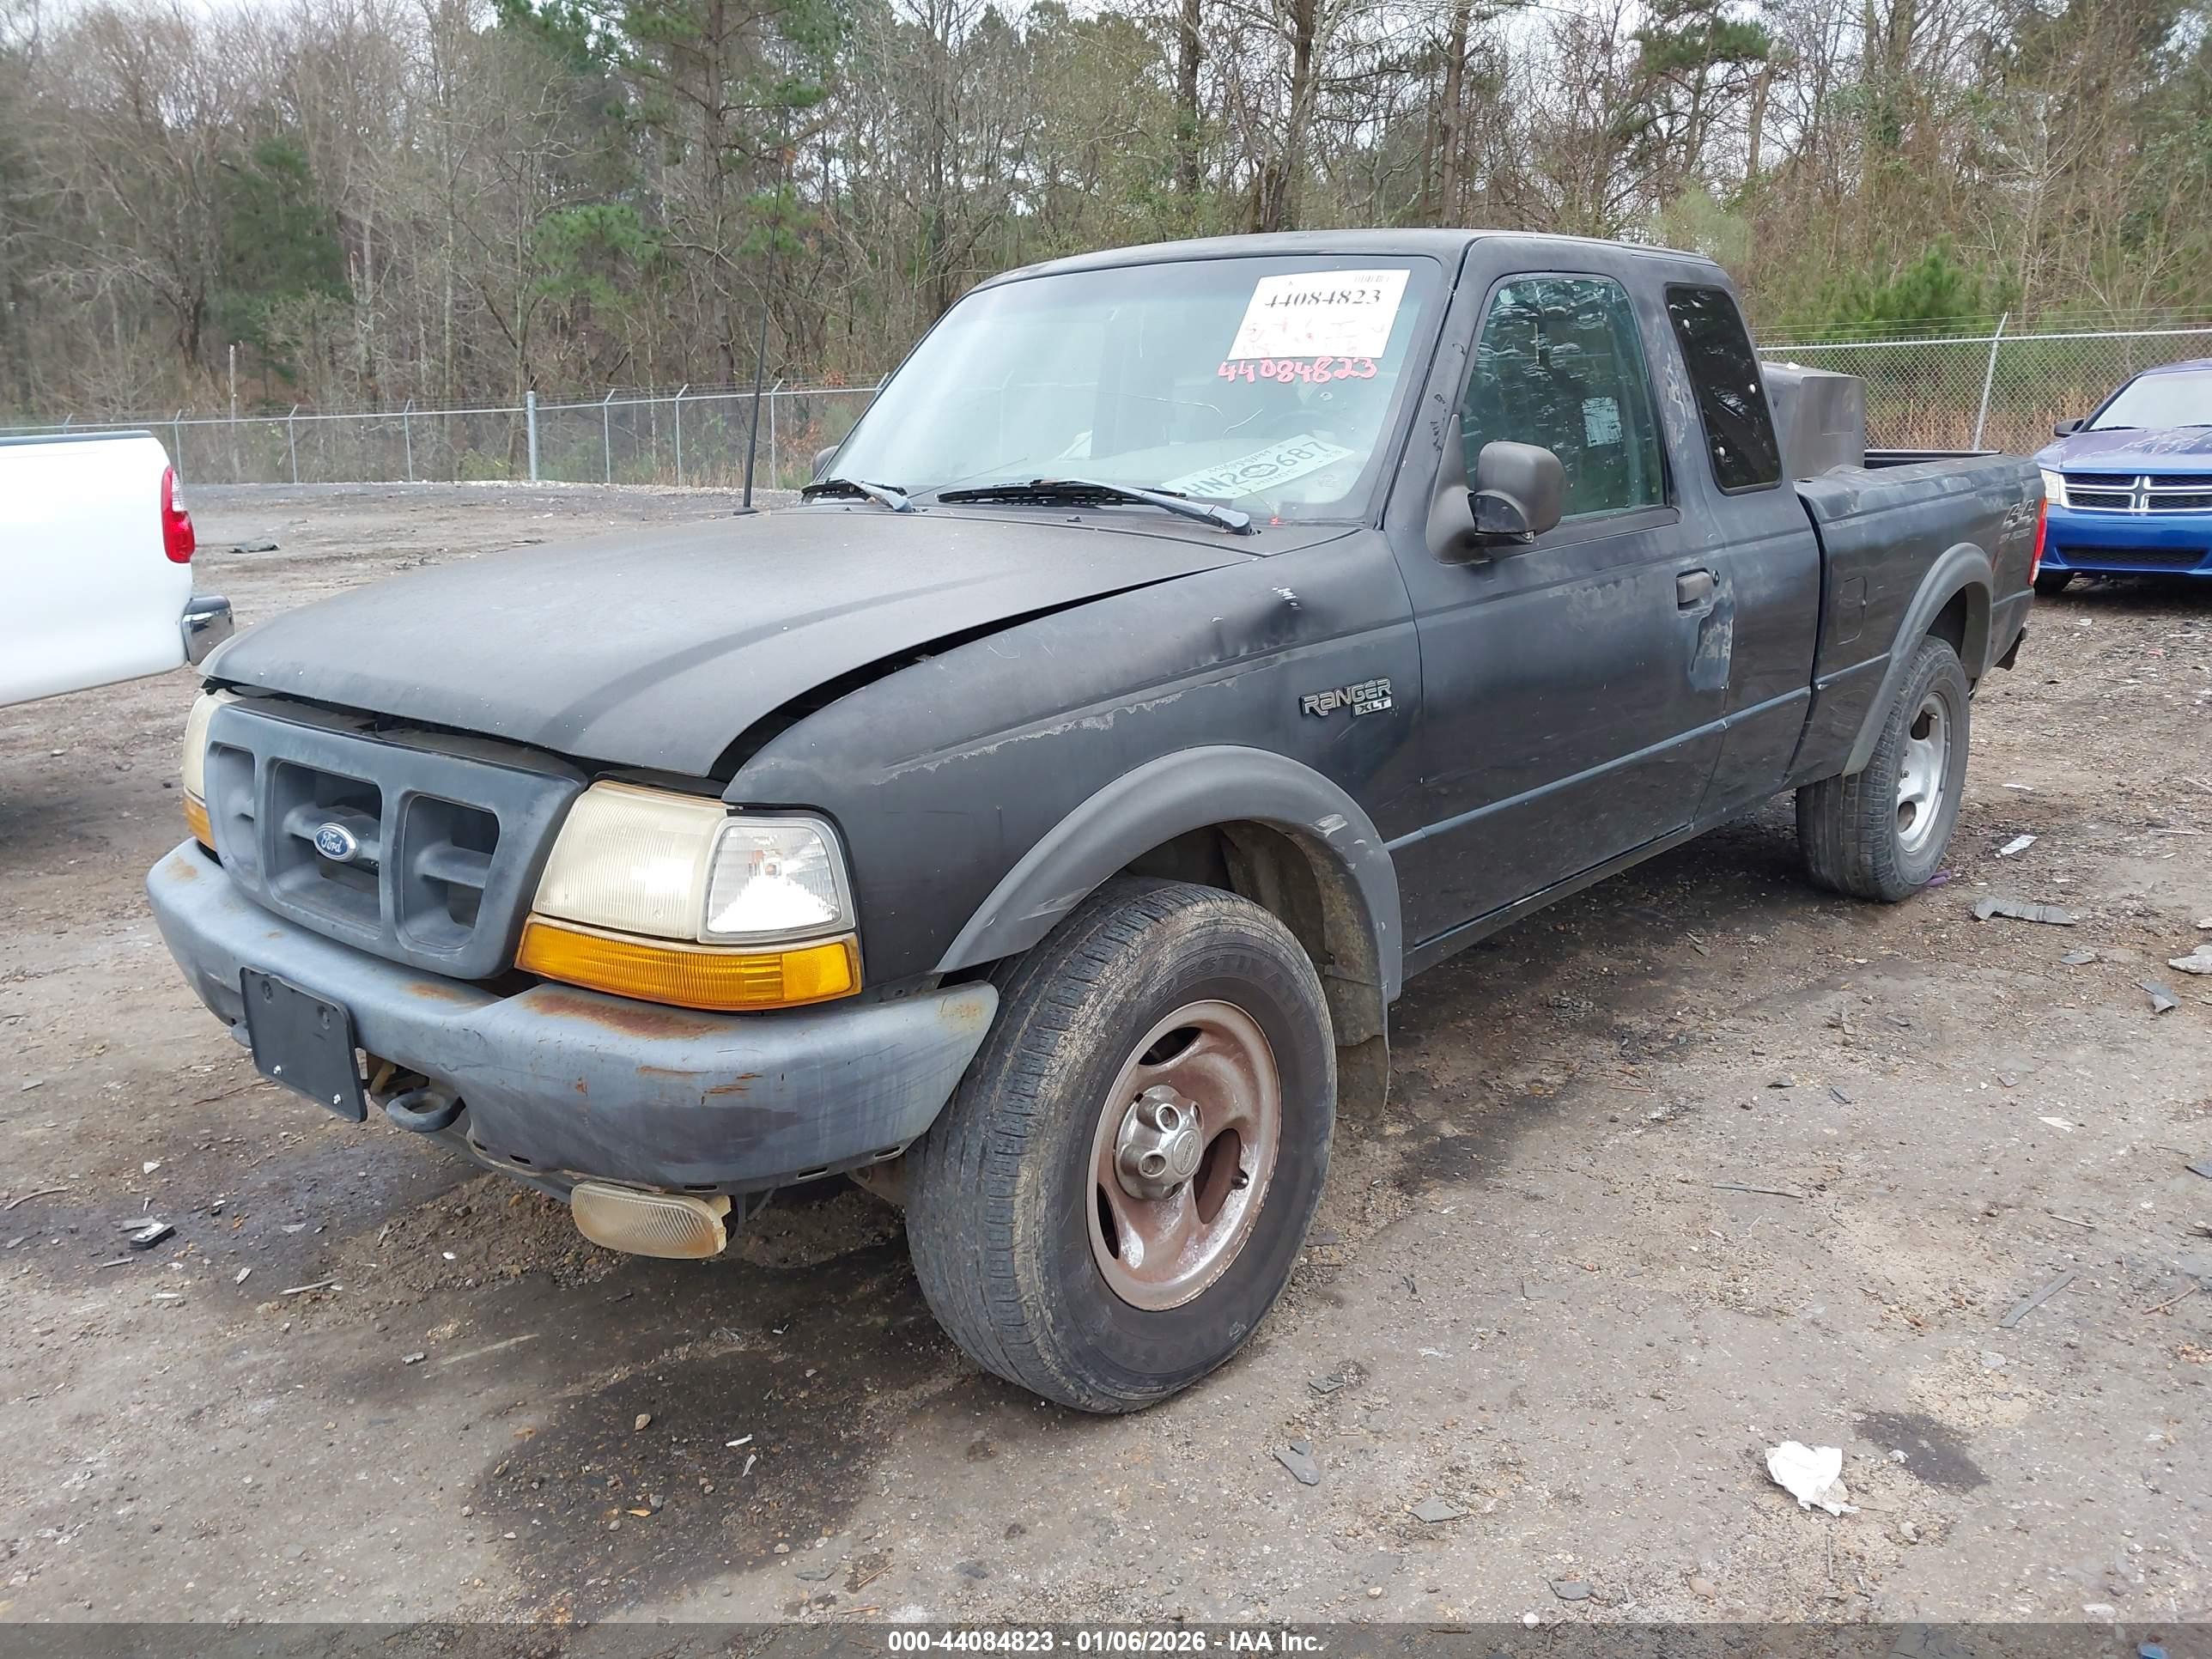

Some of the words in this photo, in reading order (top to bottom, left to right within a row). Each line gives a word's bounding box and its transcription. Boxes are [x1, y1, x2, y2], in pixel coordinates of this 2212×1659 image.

[1265, 289, 1382, 308] 44084823
[1218, 356, 1377, 383] 44084823
[1303, 678, 1392, 716] RANGER
[1359, 698, 1388, 714] XLT
[320, 830, 343, 853] Ford
